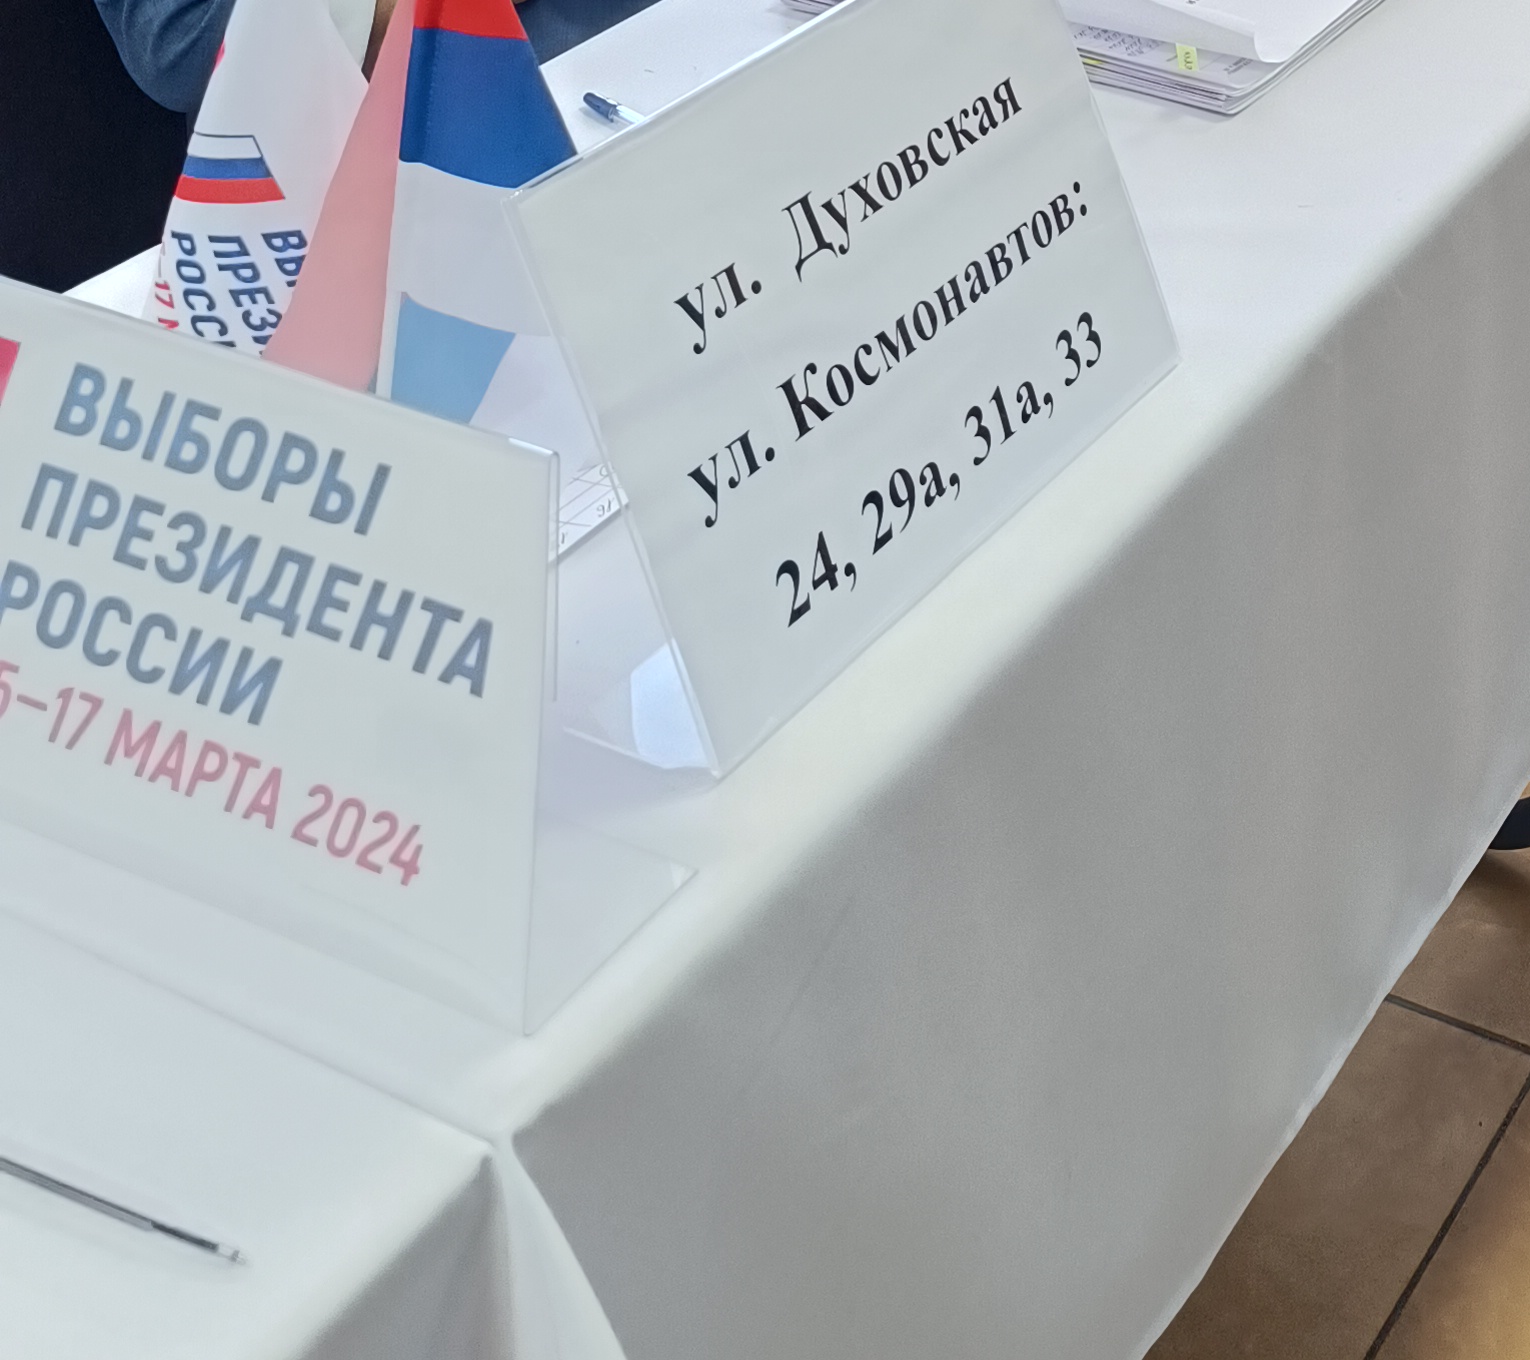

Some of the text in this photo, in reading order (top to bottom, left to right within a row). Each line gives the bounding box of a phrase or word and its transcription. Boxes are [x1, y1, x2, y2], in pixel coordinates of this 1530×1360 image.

[673, 76, 1023, 356] ул. Духовская
[53, 361, 393, 538] ВЫБОРЫ
[687, 179, 1090, 529] ул. Космонавтов:
[775, 311, 1102, 629] 24, 29а, 31а, 33
[0, 559, 285, 727] РОССИИ
[20, 462, 495, 699] ПРЕЗИДЕНТА
[103, 707, 285, 831] МАРТА
[290, 781, 426, 889] 2024
